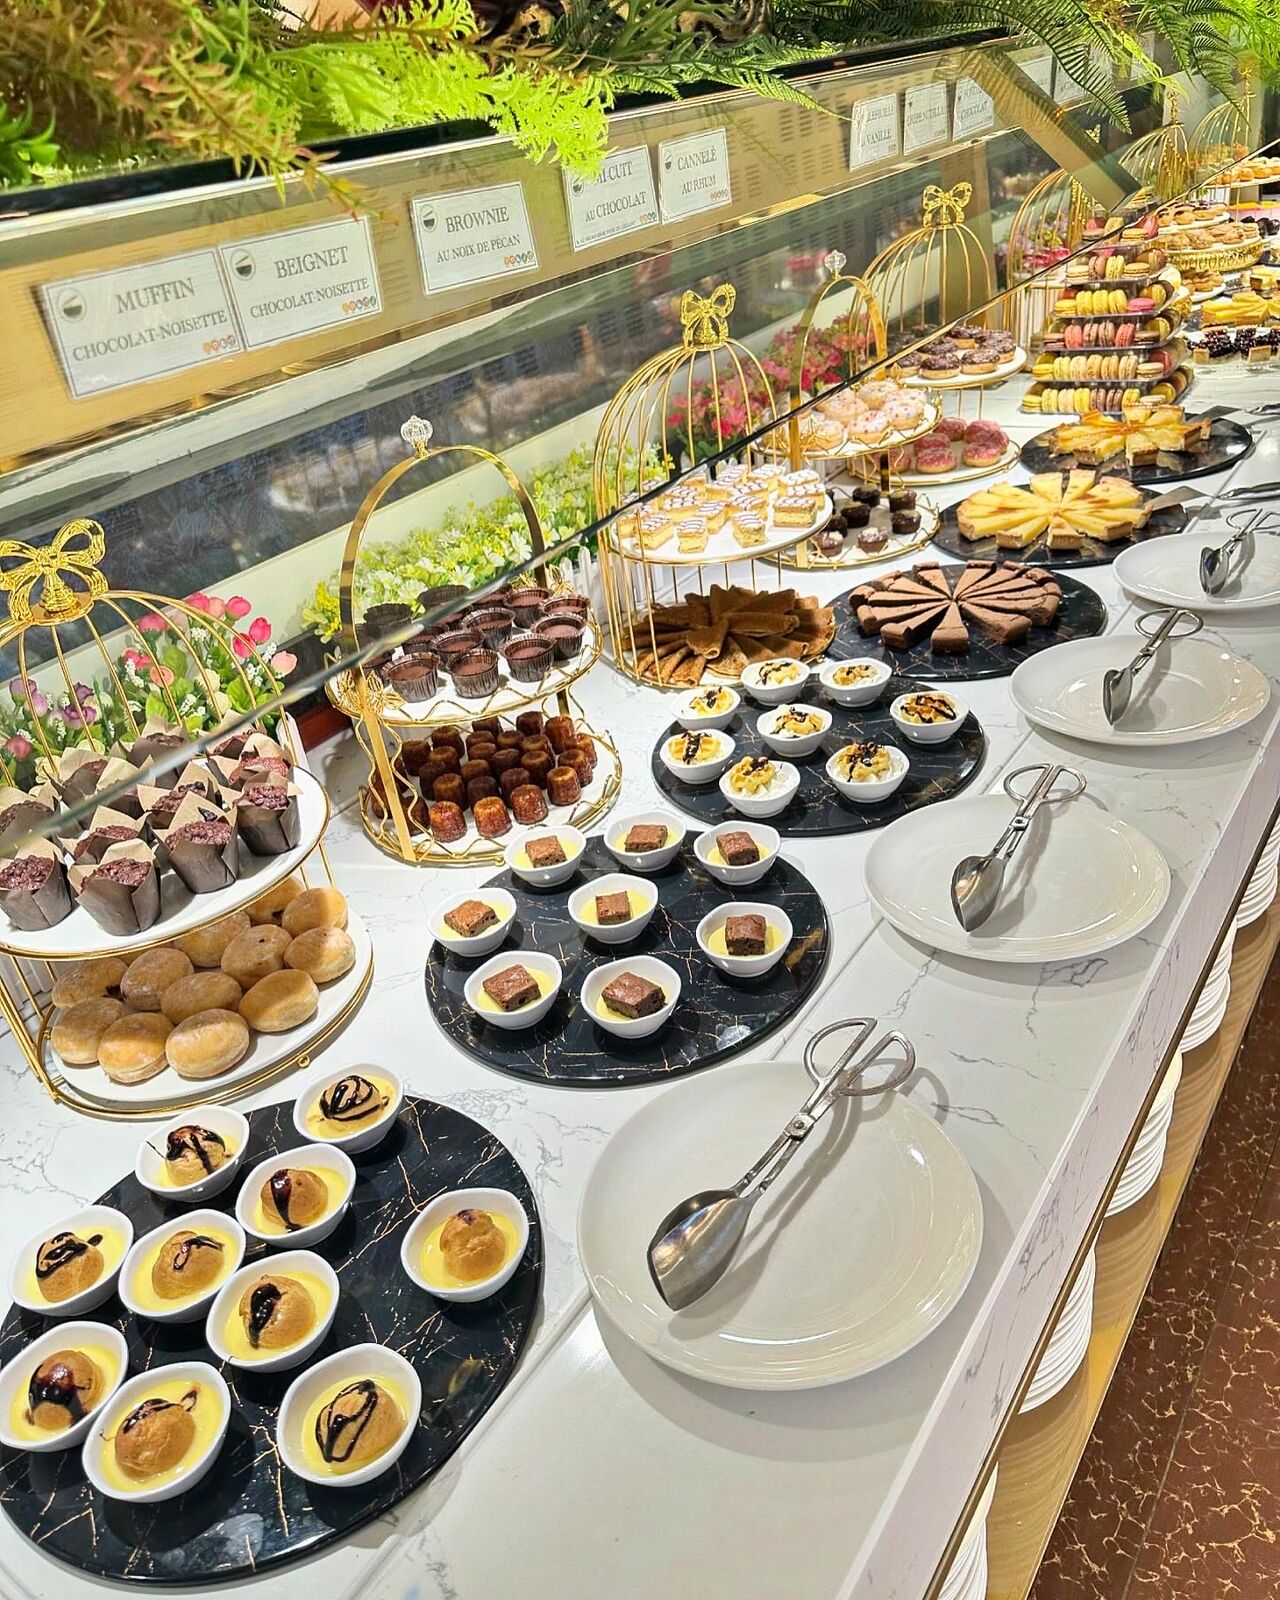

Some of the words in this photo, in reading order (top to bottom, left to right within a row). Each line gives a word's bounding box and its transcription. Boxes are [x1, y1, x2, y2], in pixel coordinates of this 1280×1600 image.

[866, 128, 892, 144] VANILLE
[677, 146, 717, 171] CANNELÉ
[682, 181, 693, 195] AU
[694, 174, 717, 191] RHUM
[445, 206, 510, 233] BROWNIE
[585, 210, 596, 222] AU
[596, 191, 646, 218] CHOCOLAT
[273, 246, 349, 279] BEIGNET
[437, 250, 450, 263] AU
[452, 244, 475, 260] NOIX
[477, 241, 490, 254] DE
[491, 234, 522, 251] PÉCAN
[114, 277, 196, 314] MUFFIN
[250, 277, 370, 319] CHOCOLAT-NOISETTE
[73, 310, 228, 362] CHOCOLAT-NOISETTE
